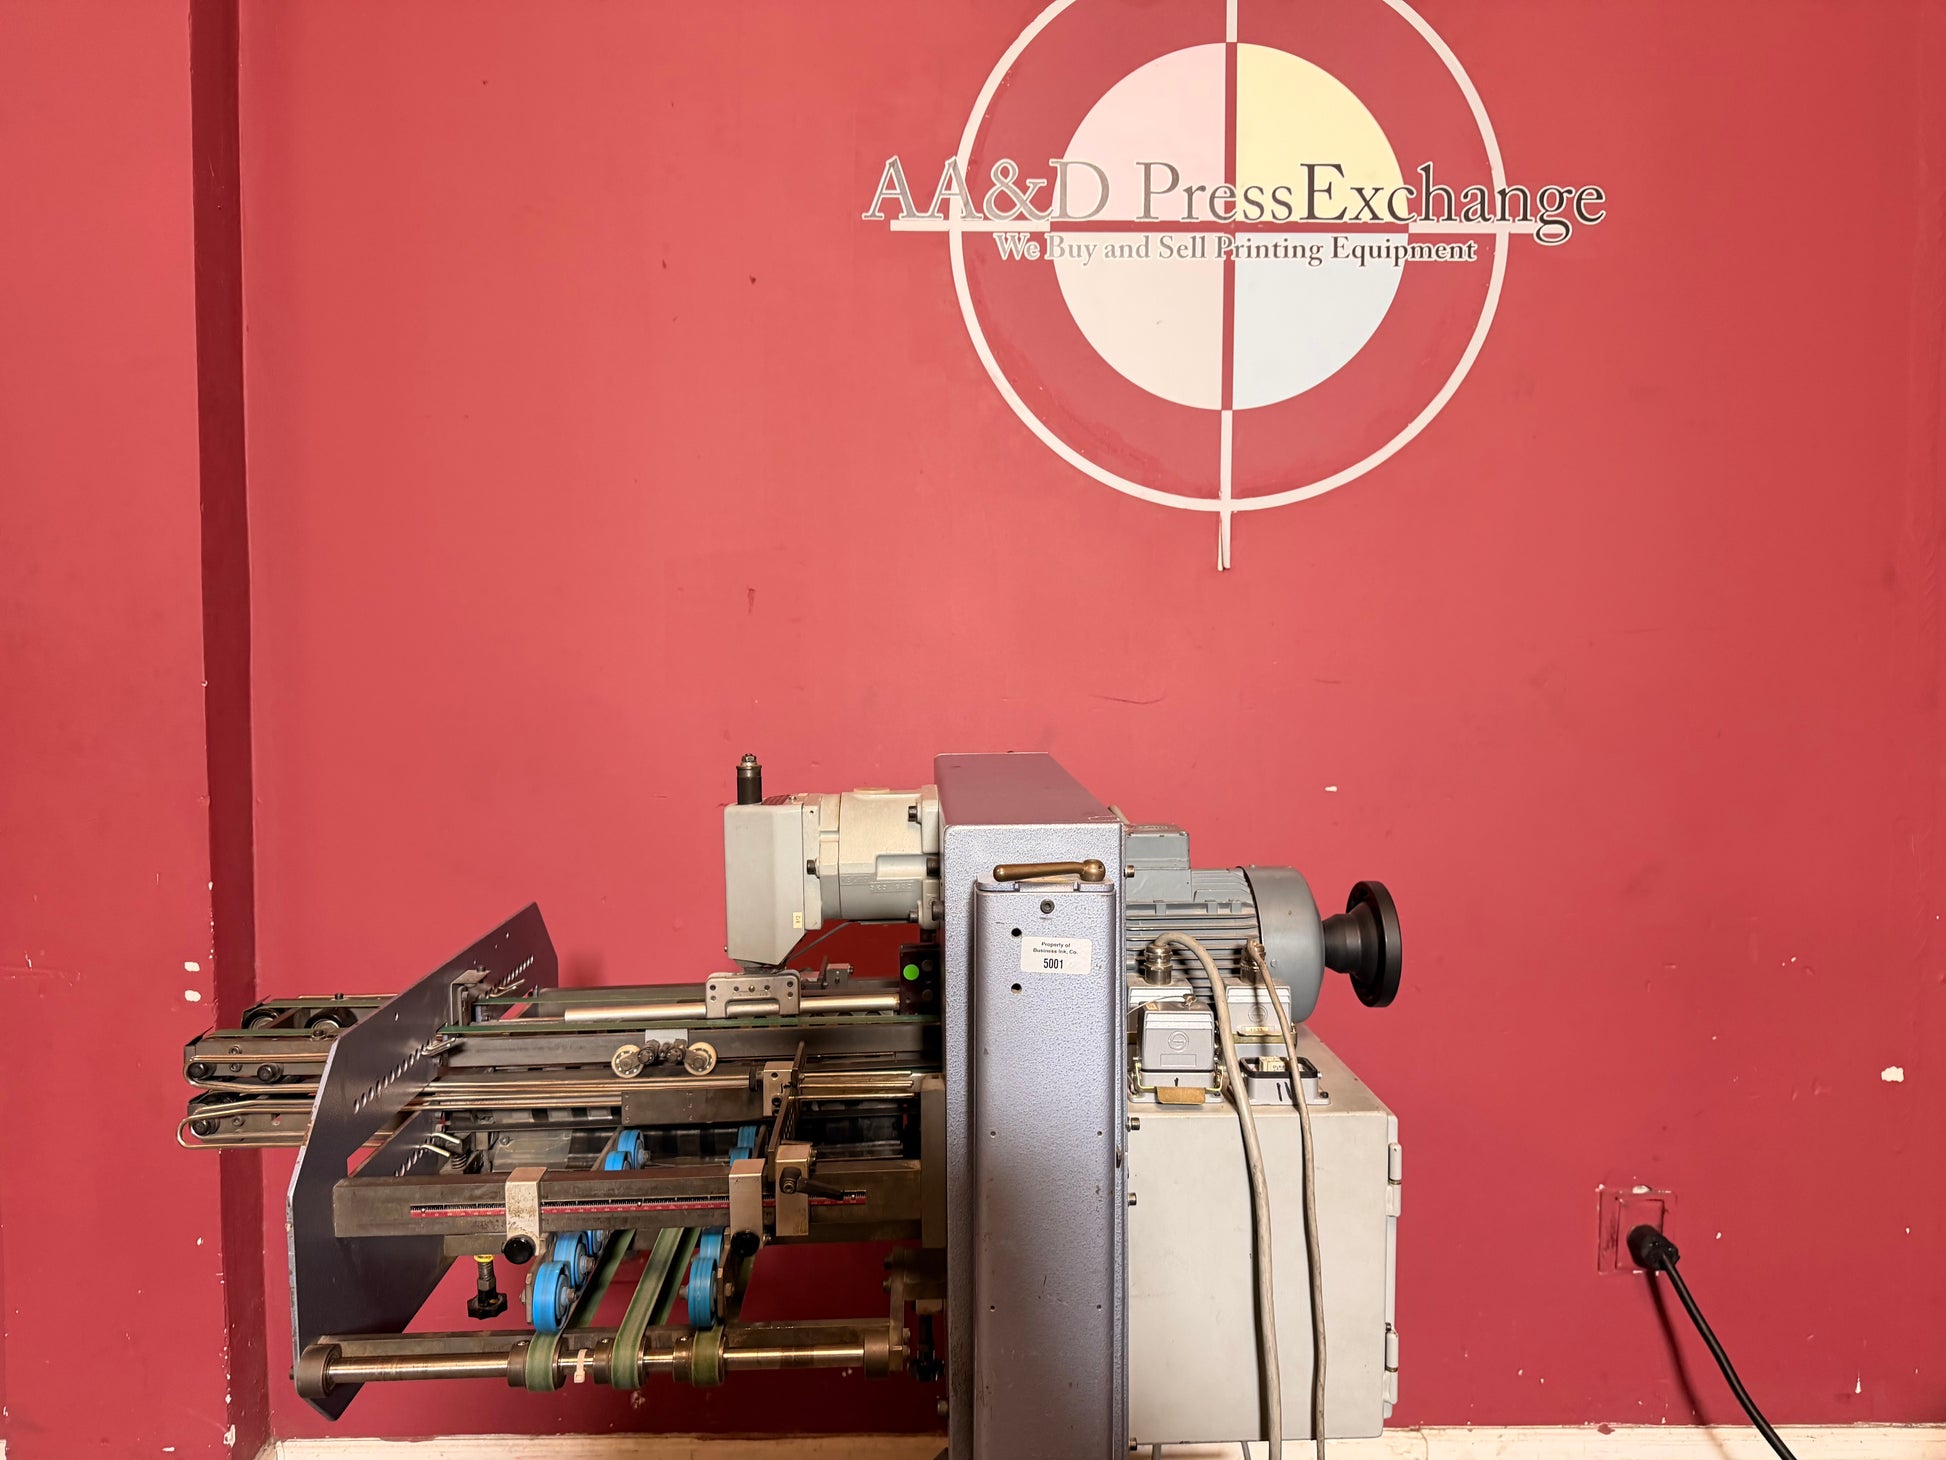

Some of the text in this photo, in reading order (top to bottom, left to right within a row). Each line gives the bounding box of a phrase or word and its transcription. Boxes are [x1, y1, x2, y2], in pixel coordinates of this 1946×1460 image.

[863, 156, 1110, 221] AA&D
[995, 232, 1477, 267] We Buy and Sell Printing Equipment
[1043, 958, 1063, 969] 5001
